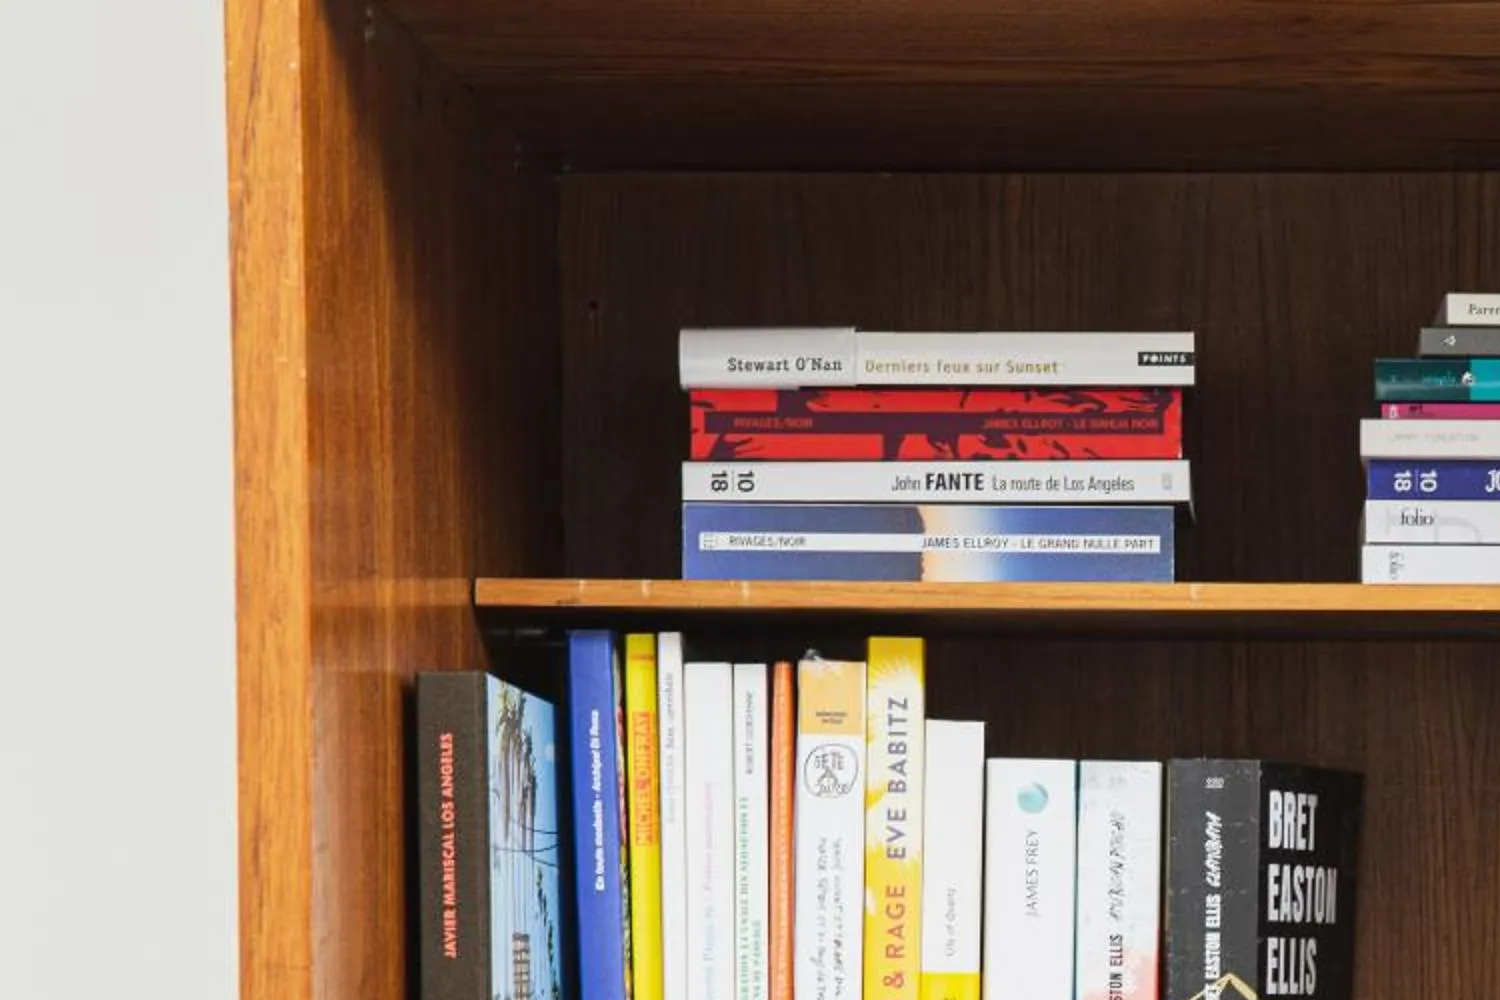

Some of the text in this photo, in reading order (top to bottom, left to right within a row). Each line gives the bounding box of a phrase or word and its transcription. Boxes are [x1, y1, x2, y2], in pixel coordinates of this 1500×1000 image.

[727, 357, 843, 372] Stewart O'Nan
[865, 359, 1059, 374] Derniers feux sur Sunset
[1142, 354, 1187, 364] POINTS
[712, 470, 728, 492] 18
[737, 470, 755, 492] 10
[891, 473, 1135, 495] John FANTE La route de Los Angeles
[1393, 470, 1412, 492] 18
[1419, 470, 1438, 492] 10
[1400, 507, 1434, 526] folio
[921, 537, 959, 549] JAMES
[962, 537, 1009, 549] ELLROY
[1020, 538, 1036, 549] LE
[1038, 538, 1079, 549] GRAND
[1124, 538, 1154, 549] PART
[886, 697, 908, 859] EVE BABITZ
[1268, 789, 1319, 851] BRET
[439, 733, 458, 959] JAVIER MARISCAL LOS ANGELES
[1025, 829, 1040, 918] JAMES FREY
[1267, 863, 1338, 924] EASTON
[885, 885, 905, 959] RAGE
[1205, 894, 1220, 928] ELLIS
[1109, 934, 1123, 966] ELLIS
[1204, 932, 1220, 979] EASTON
[1265, 936, 1318, 996] ELLIS
[883, 972, 905, 989] &
